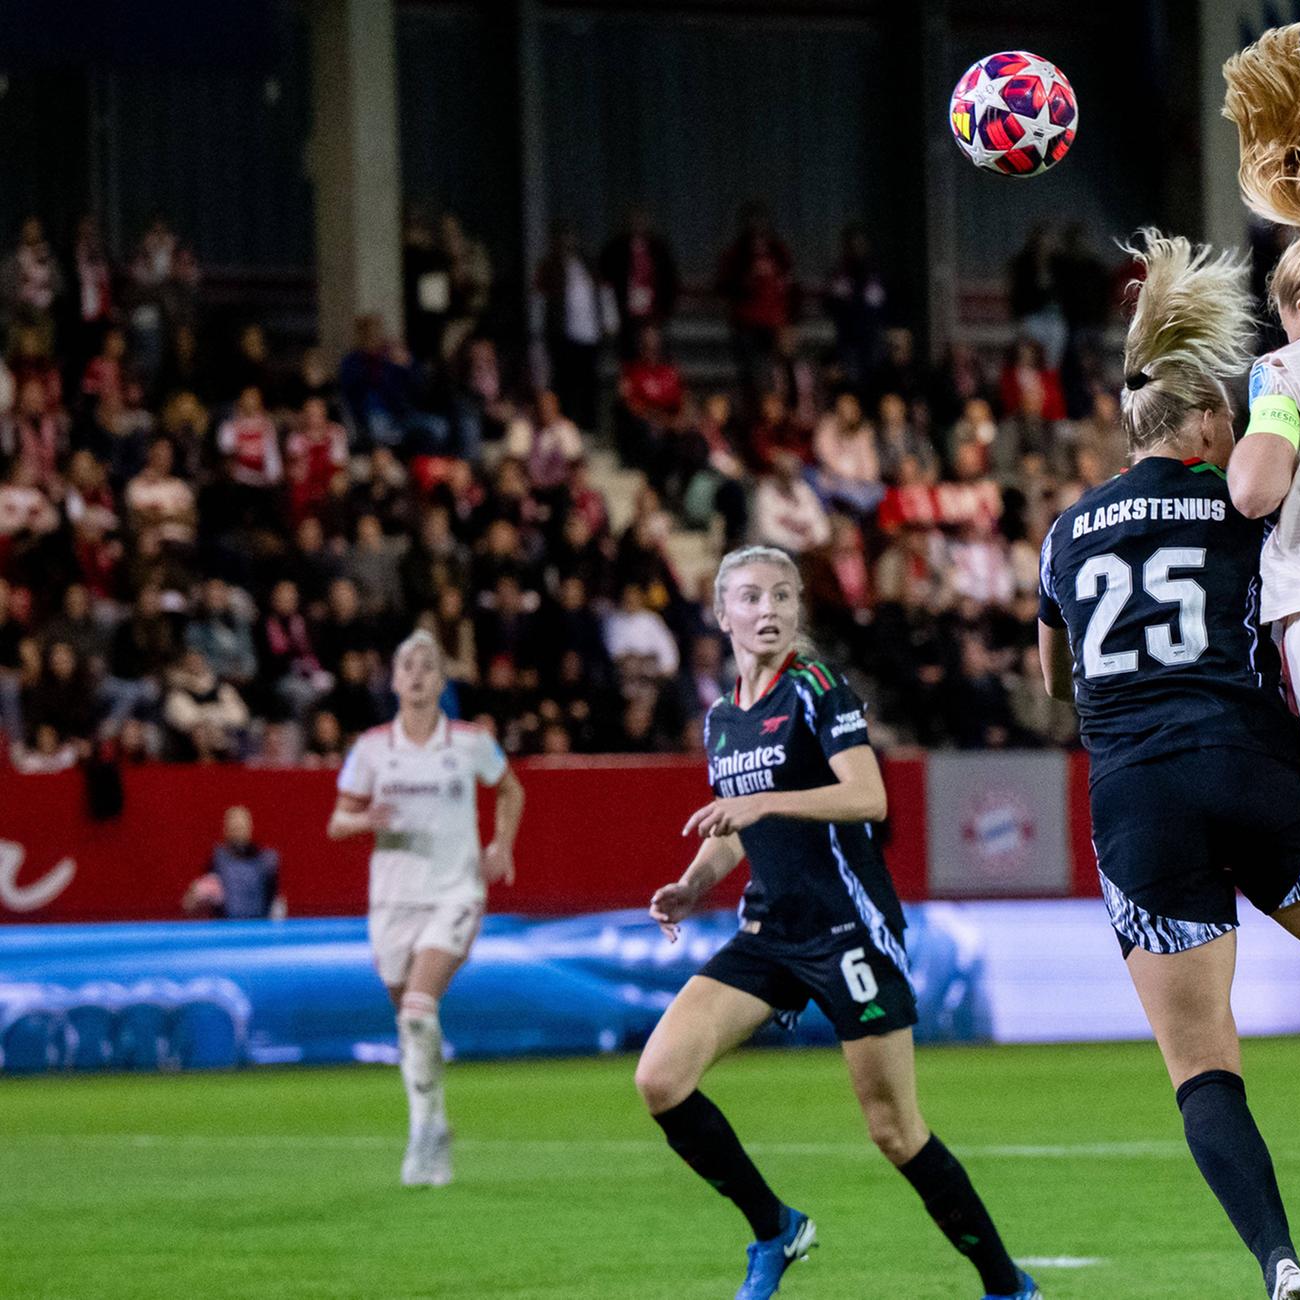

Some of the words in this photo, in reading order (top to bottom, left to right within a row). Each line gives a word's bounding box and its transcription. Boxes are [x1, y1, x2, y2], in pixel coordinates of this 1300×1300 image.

[1072, 497, 1226, 539] BLACKSTENIUS
[1076, 547, 1209, 679] 25
[712, 744, 787, 780] Emirates
[735, 768, 775, 795] BETTER
[840, 946, 879, 1004] 6
